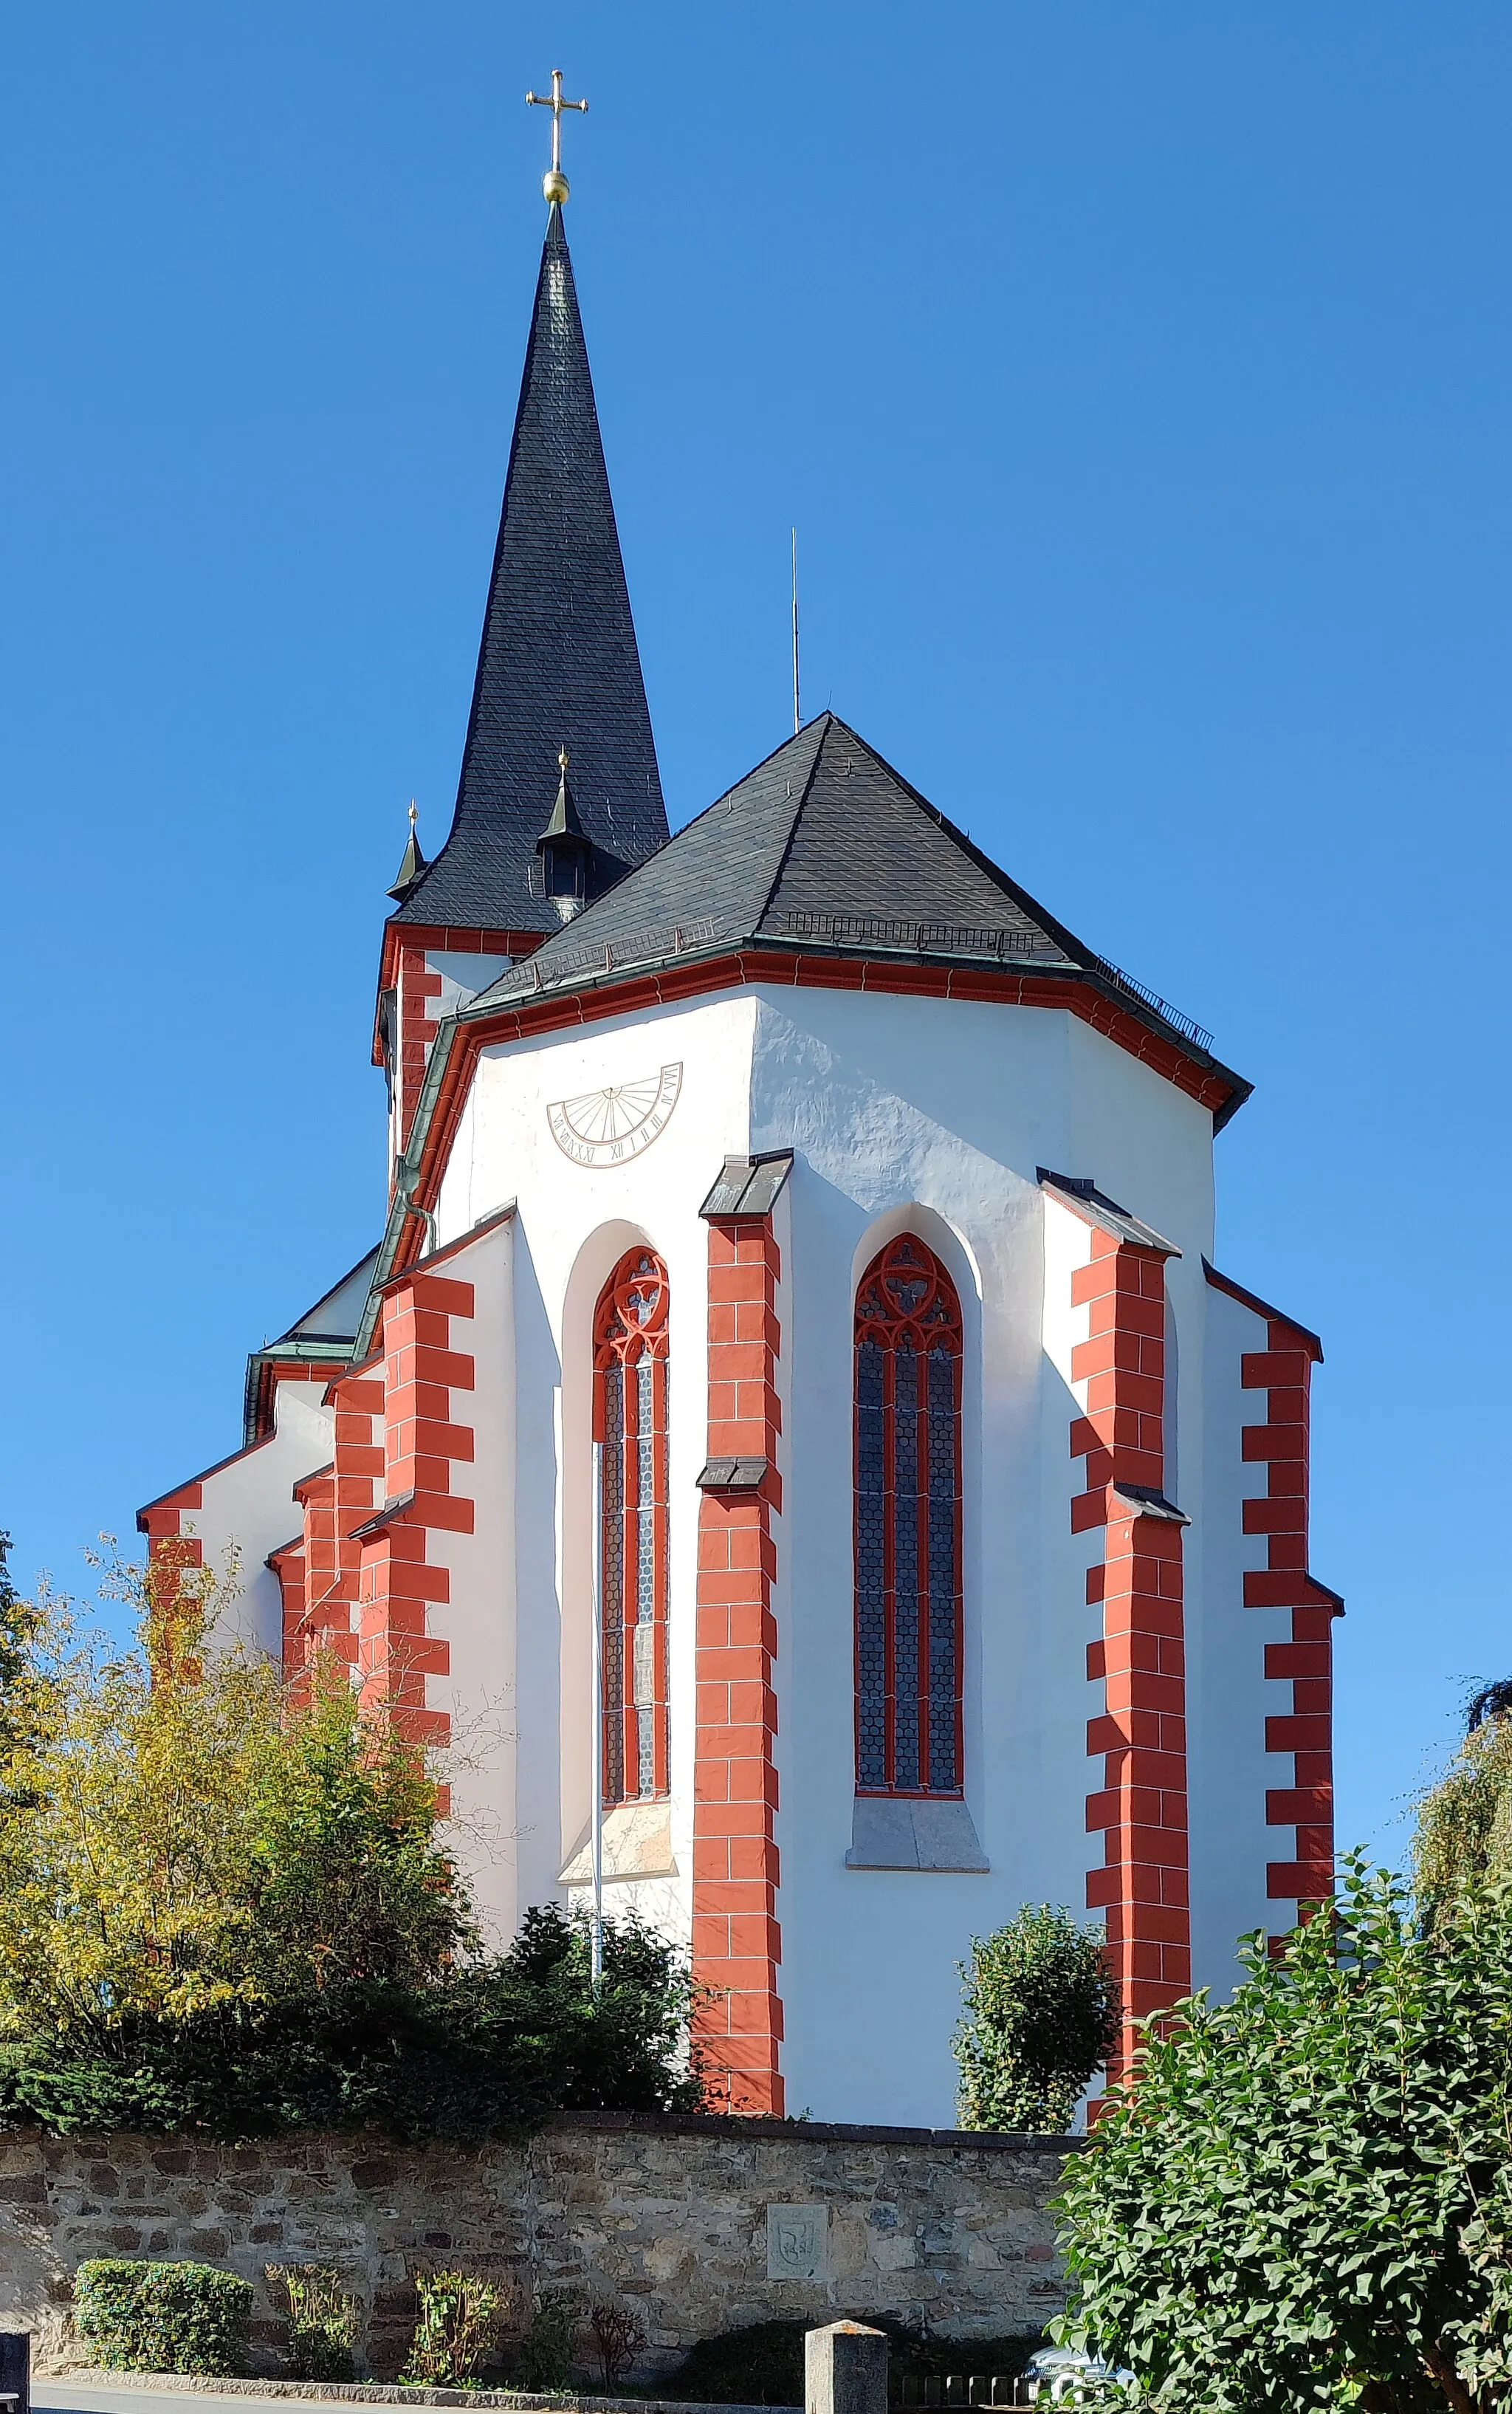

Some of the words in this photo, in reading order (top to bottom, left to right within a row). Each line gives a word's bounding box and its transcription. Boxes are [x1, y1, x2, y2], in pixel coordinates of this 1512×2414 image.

[664, 1068, 678, 1080] VI
[664, 1081, 676, 1090] V
[553, 1114, 564, 1130] VII
[650, 1114, 663, 1129] III
[641, 1128, 650, 1142] II
[611, 1142, 624, 1160] XII
[630, 1136, 636, 1151] I
